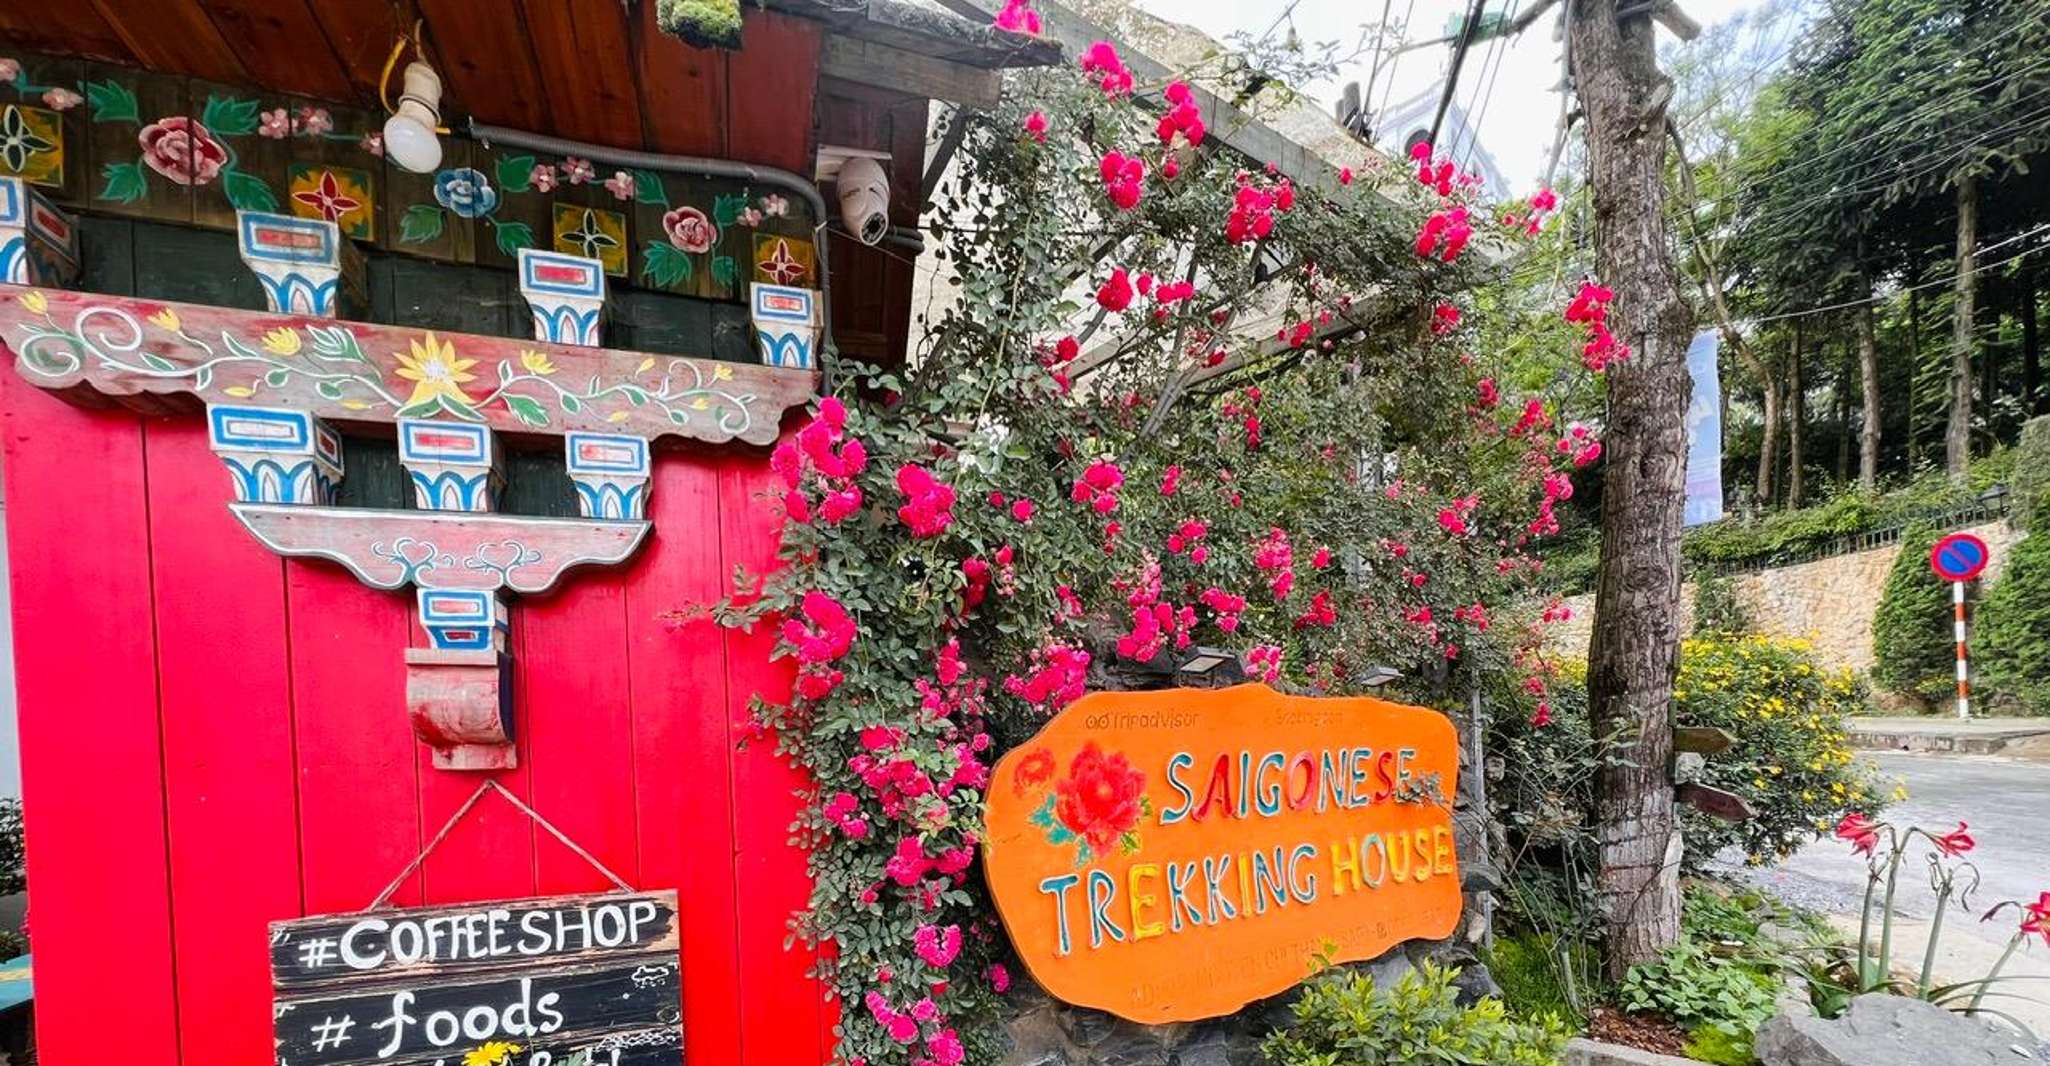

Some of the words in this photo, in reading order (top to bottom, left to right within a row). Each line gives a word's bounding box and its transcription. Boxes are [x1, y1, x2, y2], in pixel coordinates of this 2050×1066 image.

[1159, 748, 1416, 825] SAIGONESE
[1038, 843, 1318, 958] TREKKING
[1331, 824, 1454, 896] HOUSE
